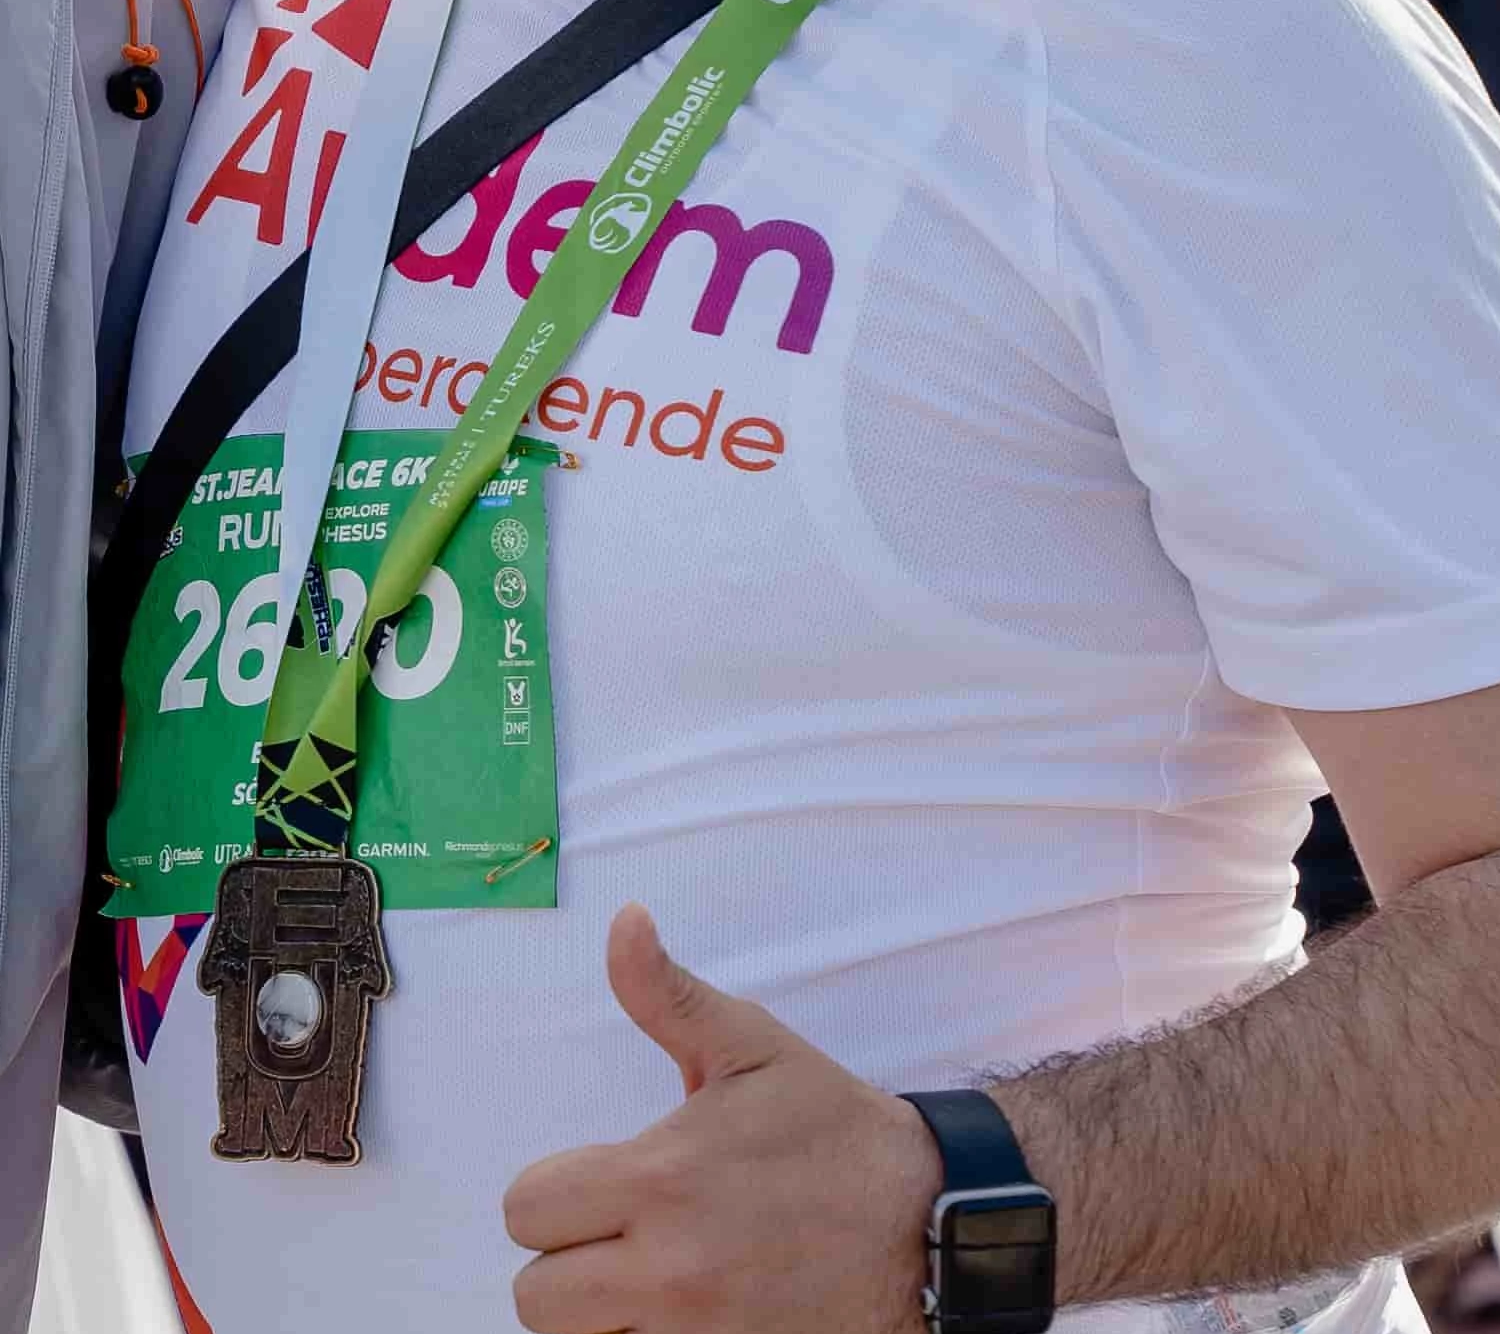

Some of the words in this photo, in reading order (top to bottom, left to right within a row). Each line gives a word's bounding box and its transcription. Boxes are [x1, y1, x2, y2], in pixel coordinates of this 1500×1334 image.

[624, 66, 726, 188] Climbolic
[479, 321, 556, 423] TUREKS
[330, 459, 388, 490] ACE
[391, 456, 437, 487] 6K
[325, 503, 392, 519] EXPLORE
[324, 522, 388, 544] HESUS
[505, 722, 529, 735] DNF
